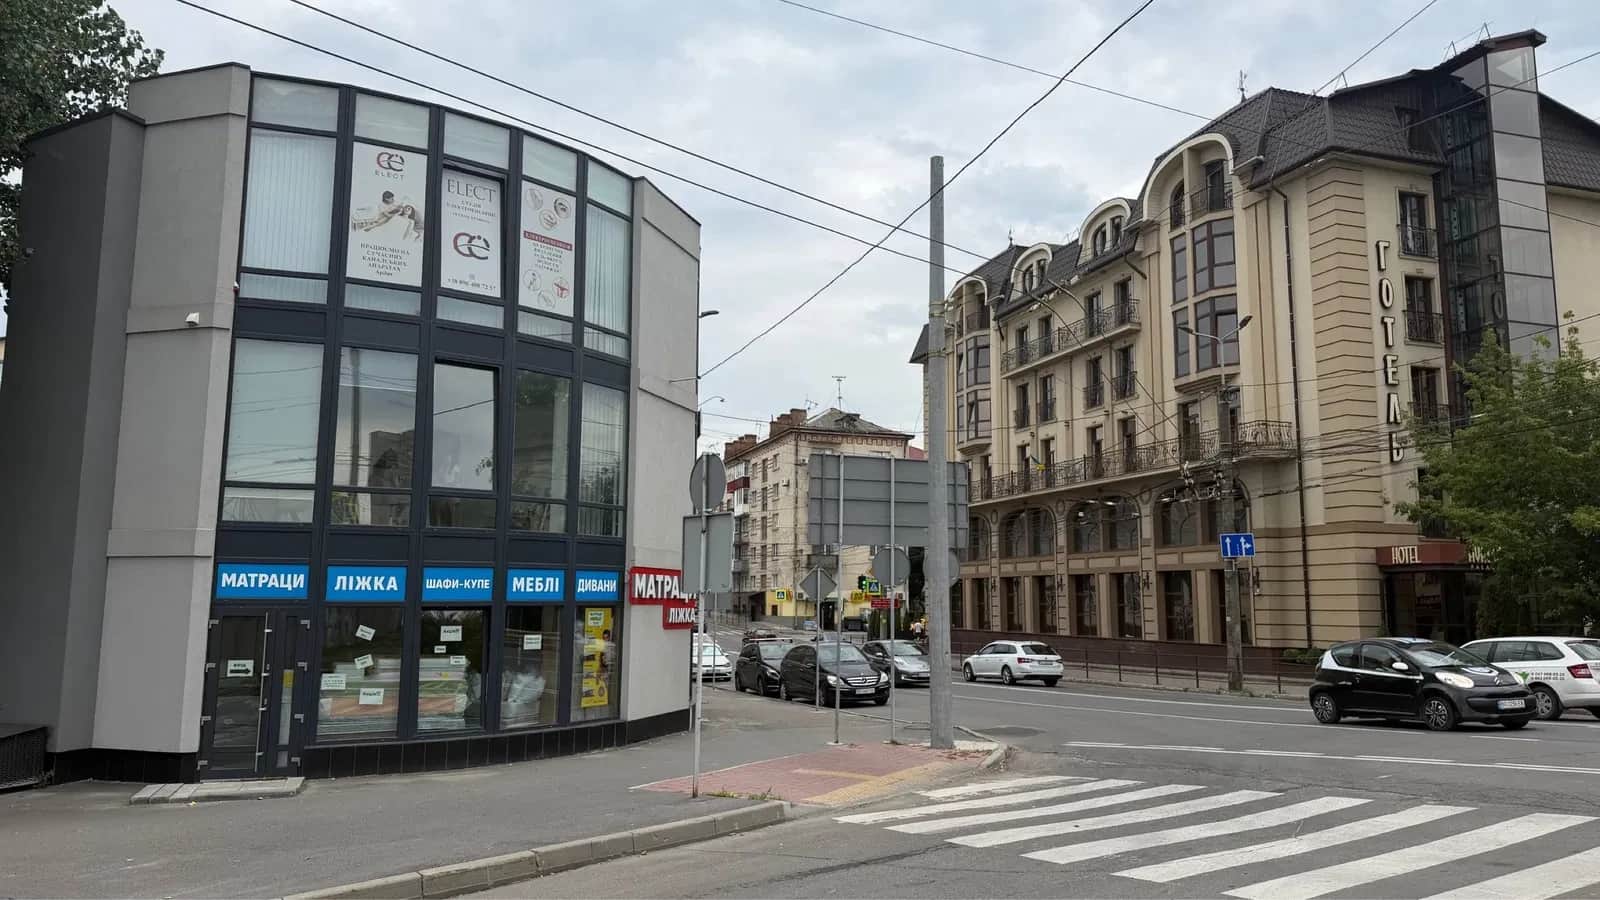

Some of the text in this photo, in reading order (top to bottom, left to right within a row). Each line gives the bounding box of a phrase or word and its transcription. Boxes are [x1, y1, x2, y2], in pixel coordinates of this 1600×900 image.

[375, 170, 405, 181] ELECT
[446, 178, 497, 203] ELECT
[1376, 240, 1404, 465] ГОТЕЛЬ
[1391, 545, 1421, 564] HOTEL
[221, 572, 305, 591] МАТРАЦИ
[334, 575, 399, 592] ЛІЖКА
[425, 578, 490, 591] ШАФИ-КУПЕ
[512, 576, 560, 593] МЕБЛІ
[577, 578, 617, 594] ДИВАНИ
[634, 573, 697, 603] МАТРА
[669, 607, 696, 624] ЛІЖКА
